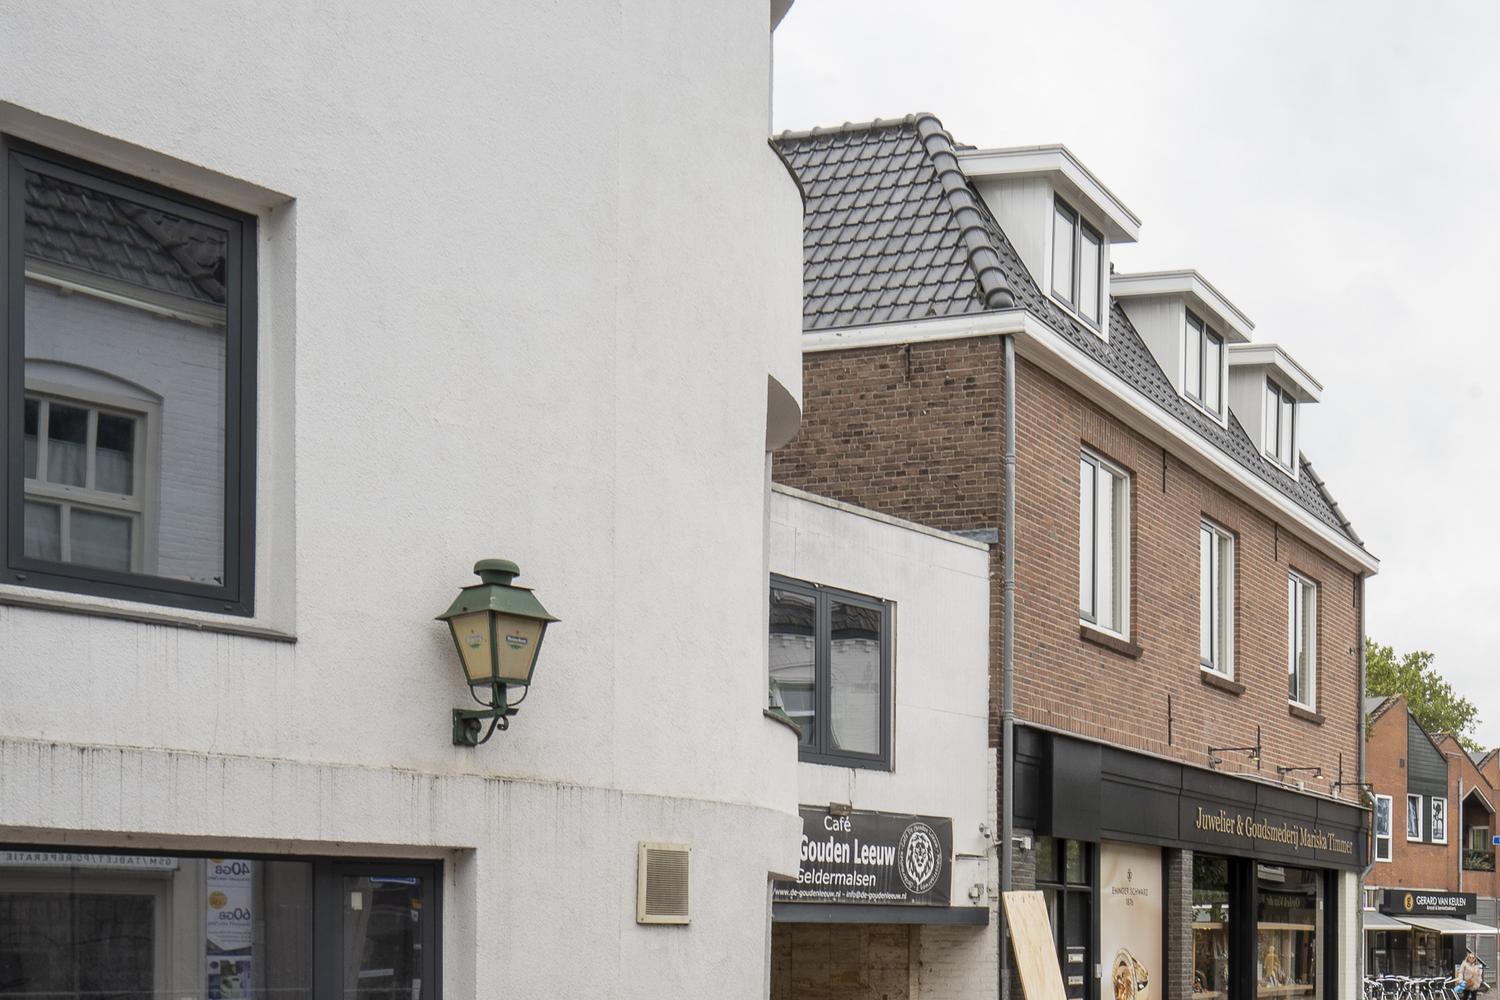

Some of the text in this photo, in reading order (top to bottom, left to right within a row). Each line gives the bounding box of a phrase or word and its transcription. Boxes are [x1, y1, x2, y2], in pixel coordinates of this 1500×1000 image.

[824, 815, 851, 832] Café
[1196, 807, 1353, 854] Juwelier & Goudsmederij Mariska Timmer
[800, 834, 895, 866] Gouden Leeuw
[796, 868, 876, 886] Geldermalsen
[1416, 895, 1466, 906] GERARD VAN KEULEN
